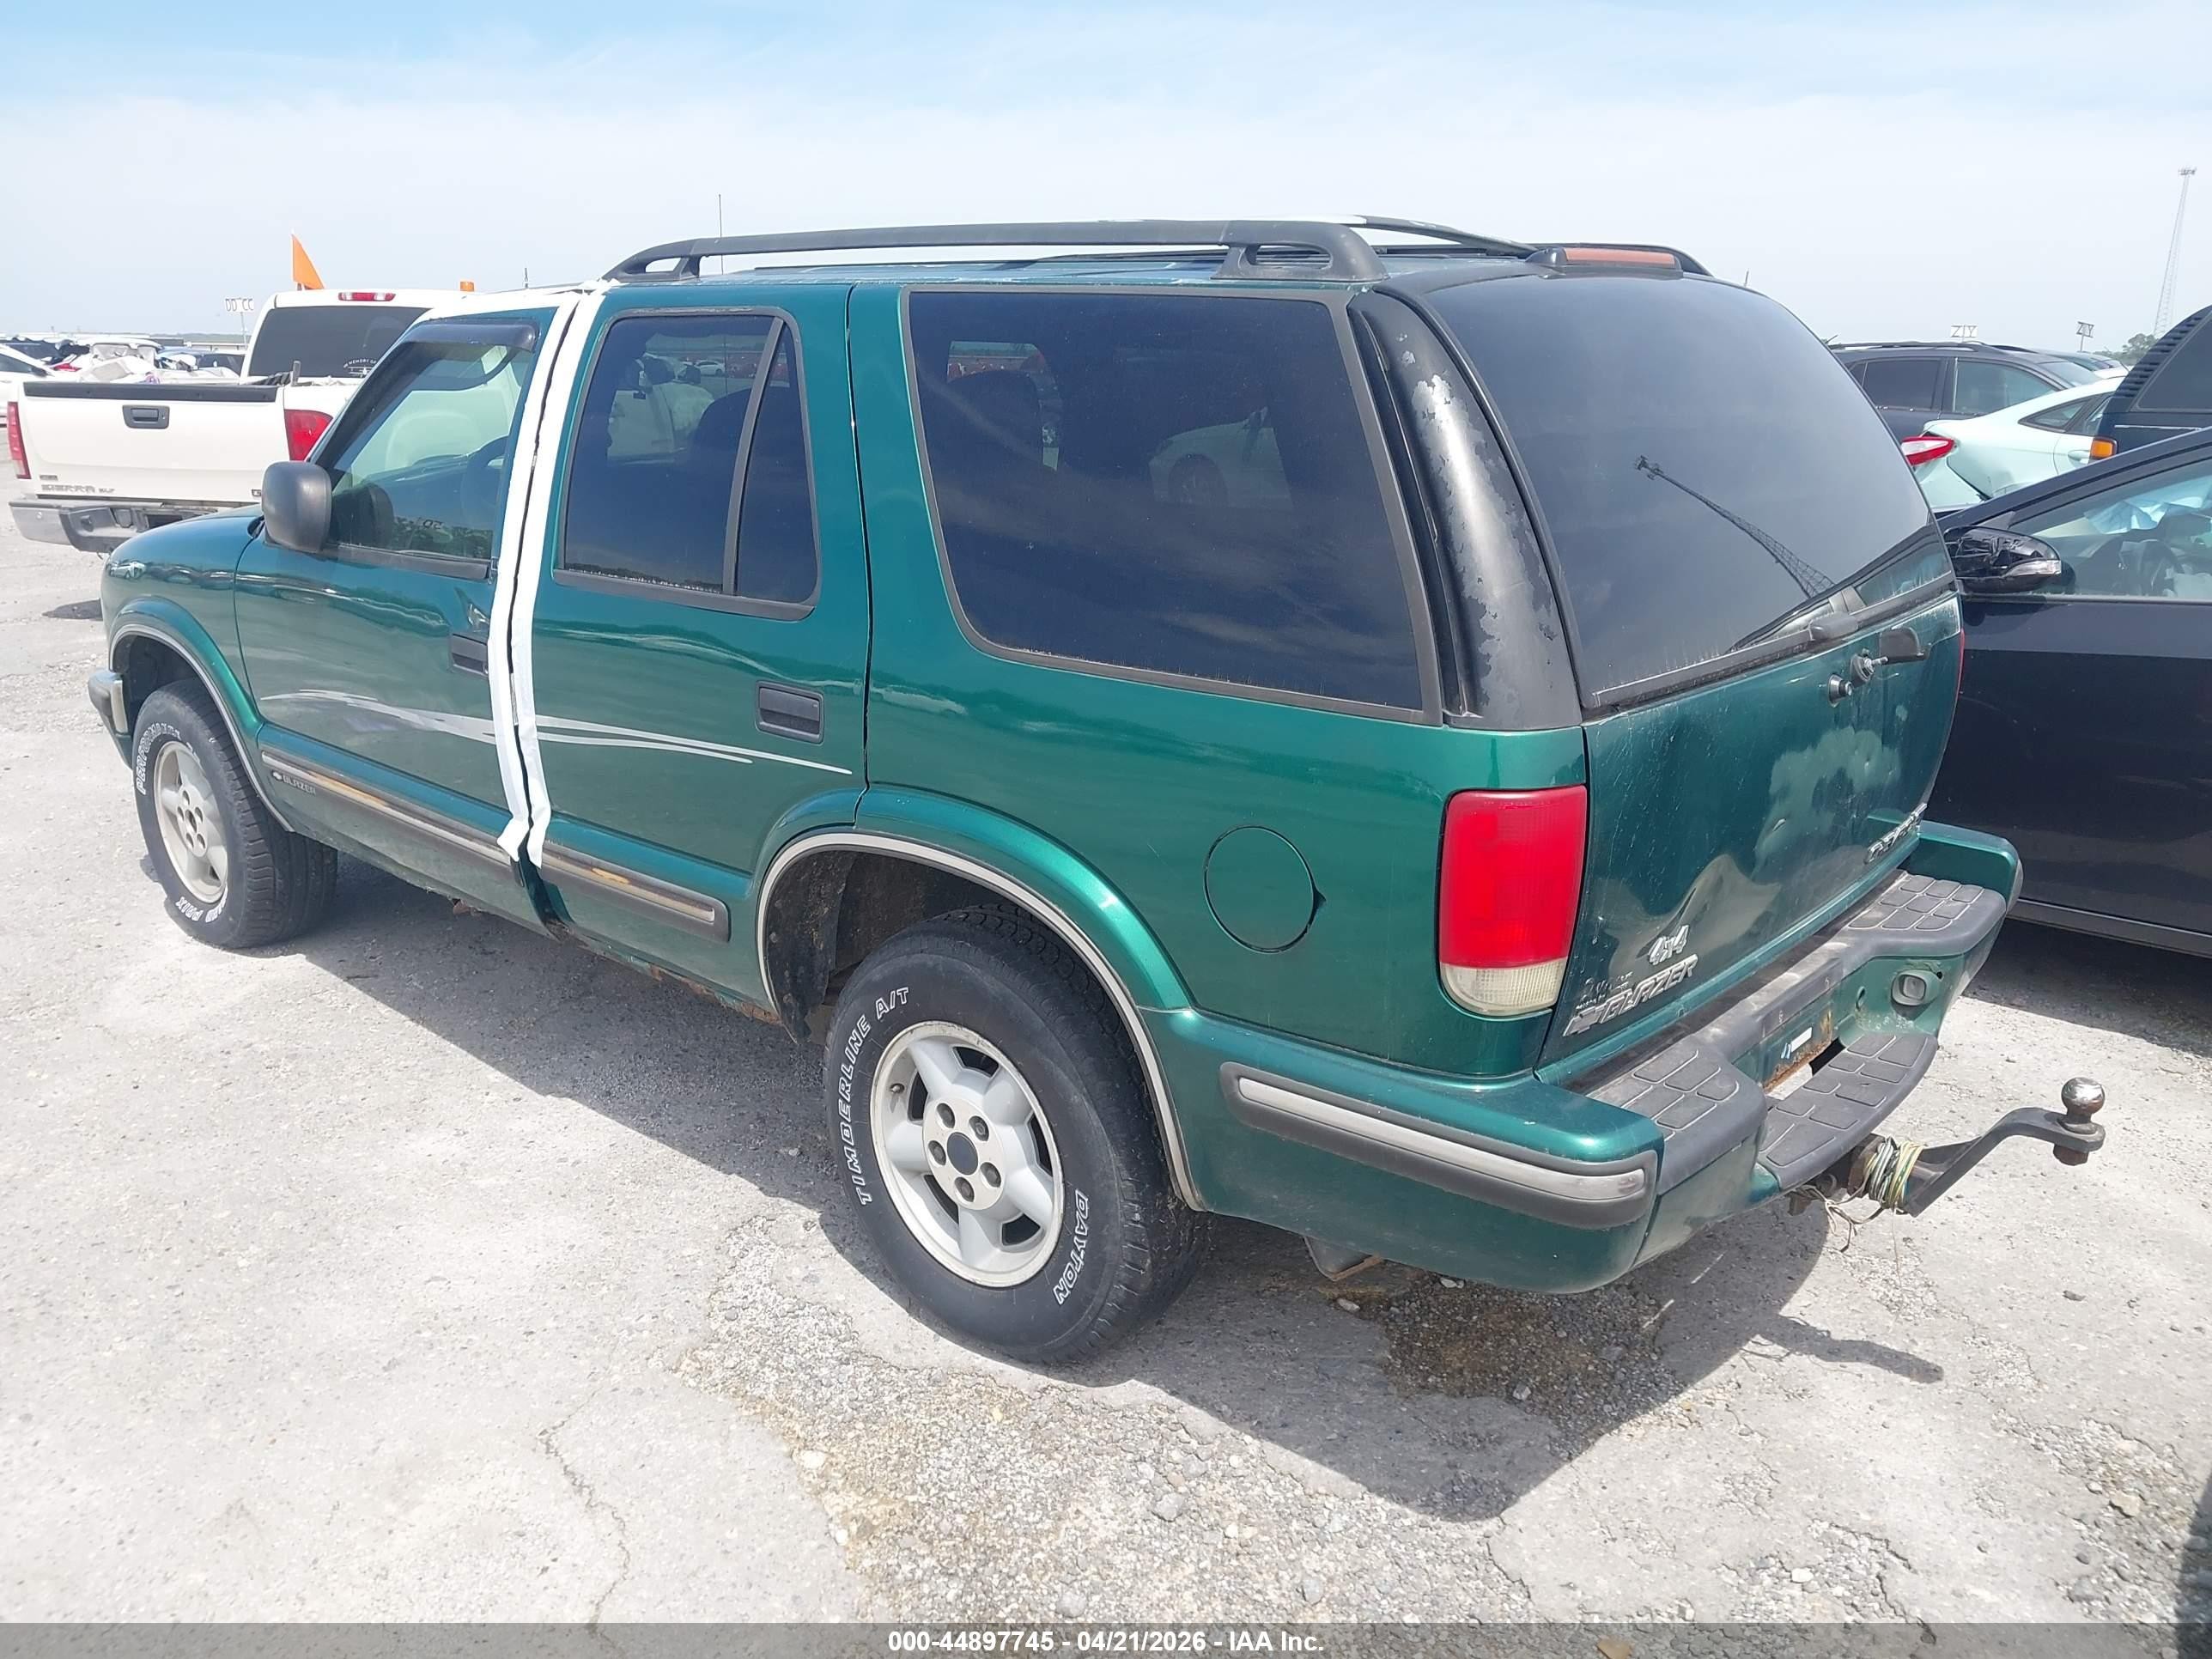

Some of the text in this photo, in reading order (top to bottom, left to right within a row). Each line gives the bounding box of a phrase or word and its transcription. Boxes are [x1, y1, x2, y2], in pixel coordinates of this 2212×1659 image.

[1601, 954, 1698, 1024] BLAZER
[838, 987, 910, 1206] TIMBERLINE A/T
[1054, 1189, 1089, 1305] DAYTON
